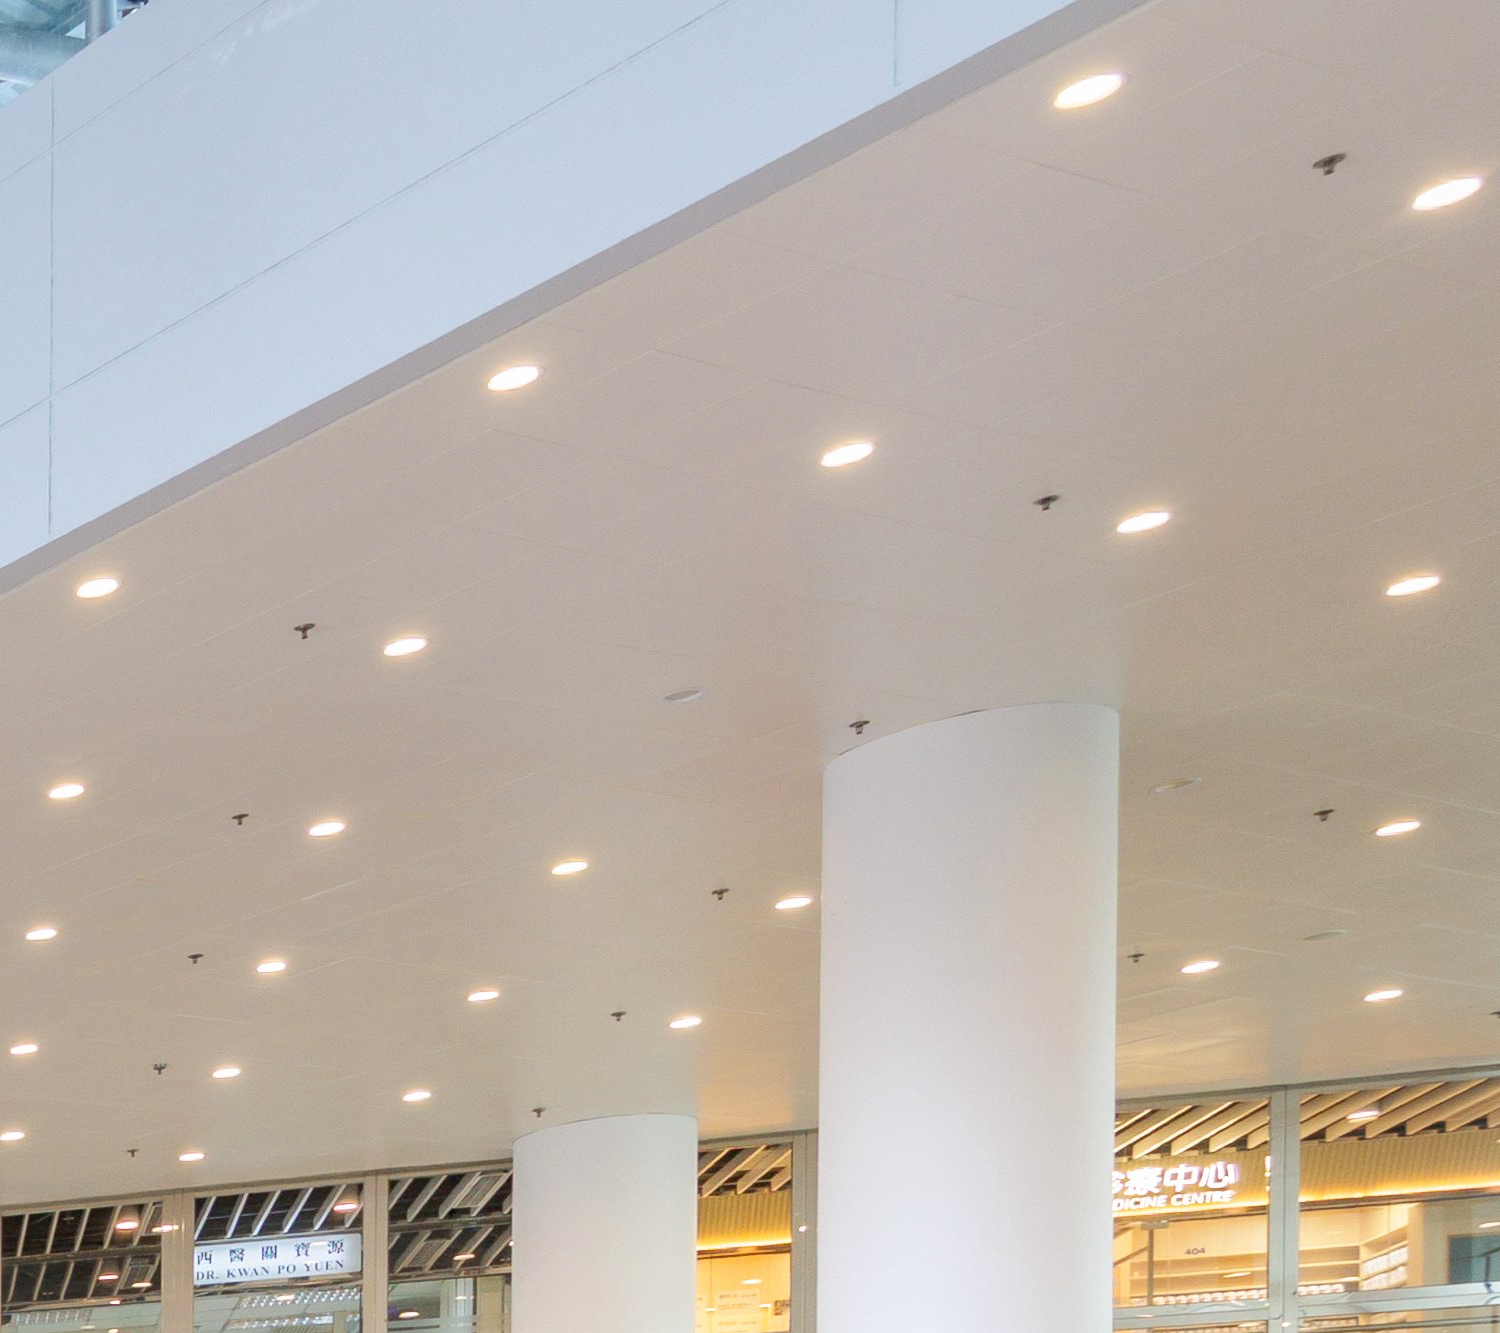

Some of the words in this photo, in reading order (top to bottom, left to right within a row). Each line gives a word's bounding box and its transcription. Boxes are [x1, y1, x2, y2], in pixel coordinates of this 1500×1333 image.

[1171, 1190, 1236, 1206] CENTRE
[196, 1271, 218, 1281] DR.
[227, 1267, 270, 1279] KWAN
[277, 1264, 296, 1274] PO
[304, 1260, 344, 1272] YUEN
